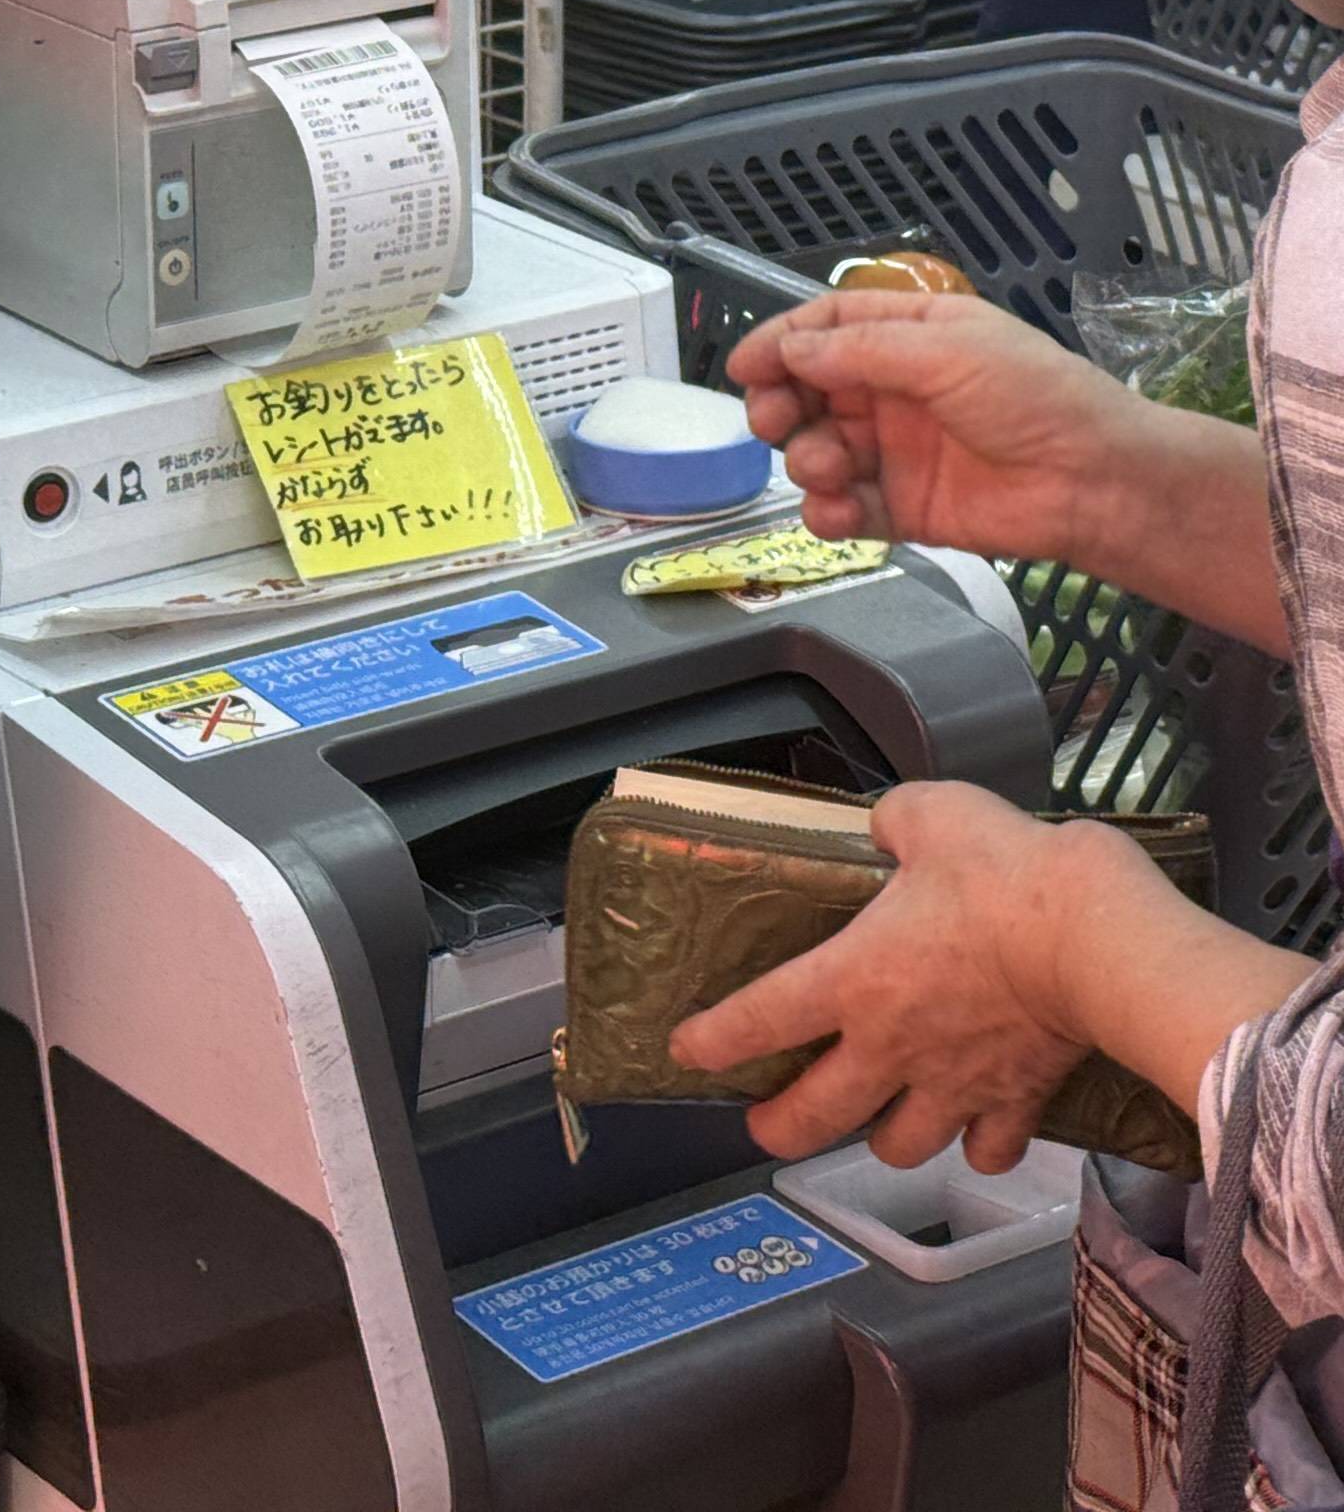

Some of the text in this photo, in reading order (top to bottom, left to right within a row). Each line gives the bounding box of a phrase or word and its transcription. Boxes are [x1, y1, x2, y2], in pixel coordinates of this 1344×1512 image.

[247, 354, 466, 429] お釣りをとったら
[262, 409, 445, 465] レシートがでます。
[277, 457, 372, 510] かならず
[297, 488, 514, 549] お取り下さい!!!
[241, 617, 449, 680] お札は横向きにして
[258, 644, 418, 692] 入れてください
[476, 1206, 763, 1316] 小銭のお預かりは 30 枚まで
[498, 1258, 676, 1331] とさせて頂きます
